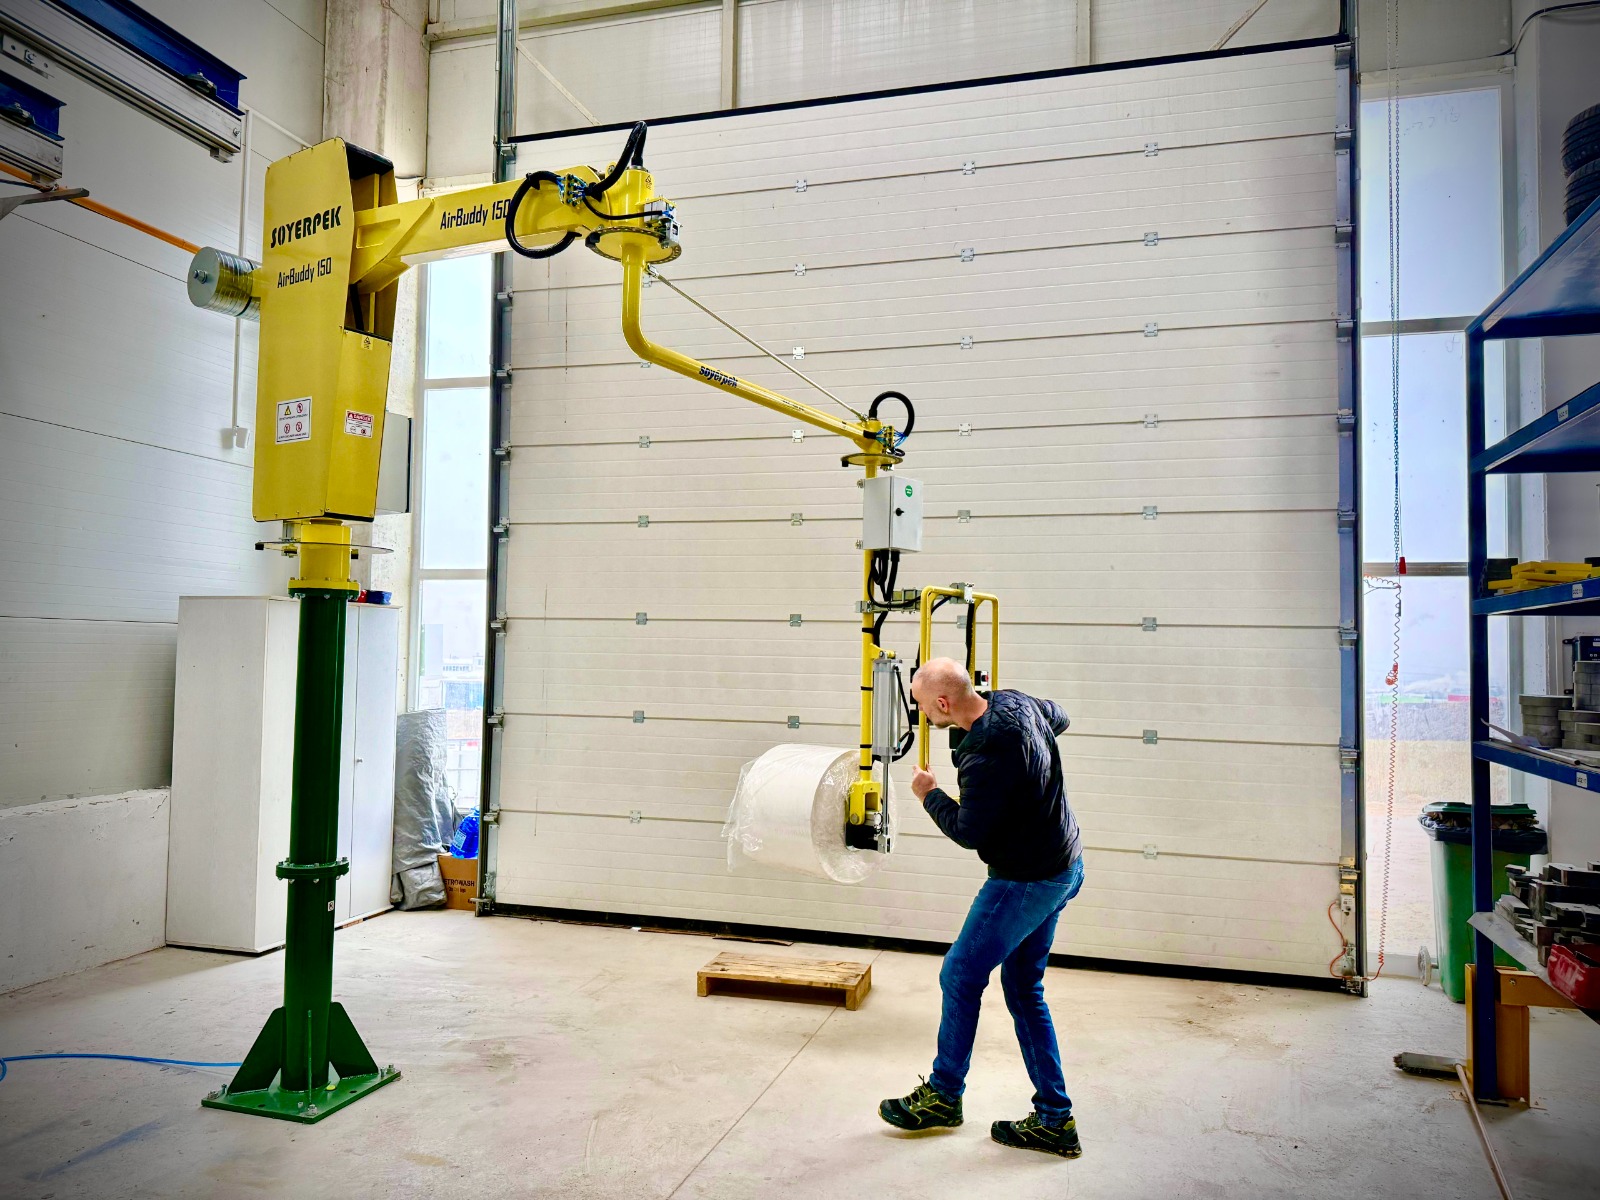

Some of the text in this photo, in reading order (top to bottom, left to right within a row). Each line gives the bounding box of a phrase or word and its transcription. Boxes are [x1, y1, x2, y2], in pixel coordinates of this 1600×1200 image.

[270, 205, 342, 248] SOYERPEK
[440, 199, 511, 230] AirBuddy 150
[277, 256, 332, 289] AirBuddy 150
[444, 879, 475, 887] ETROWASH
